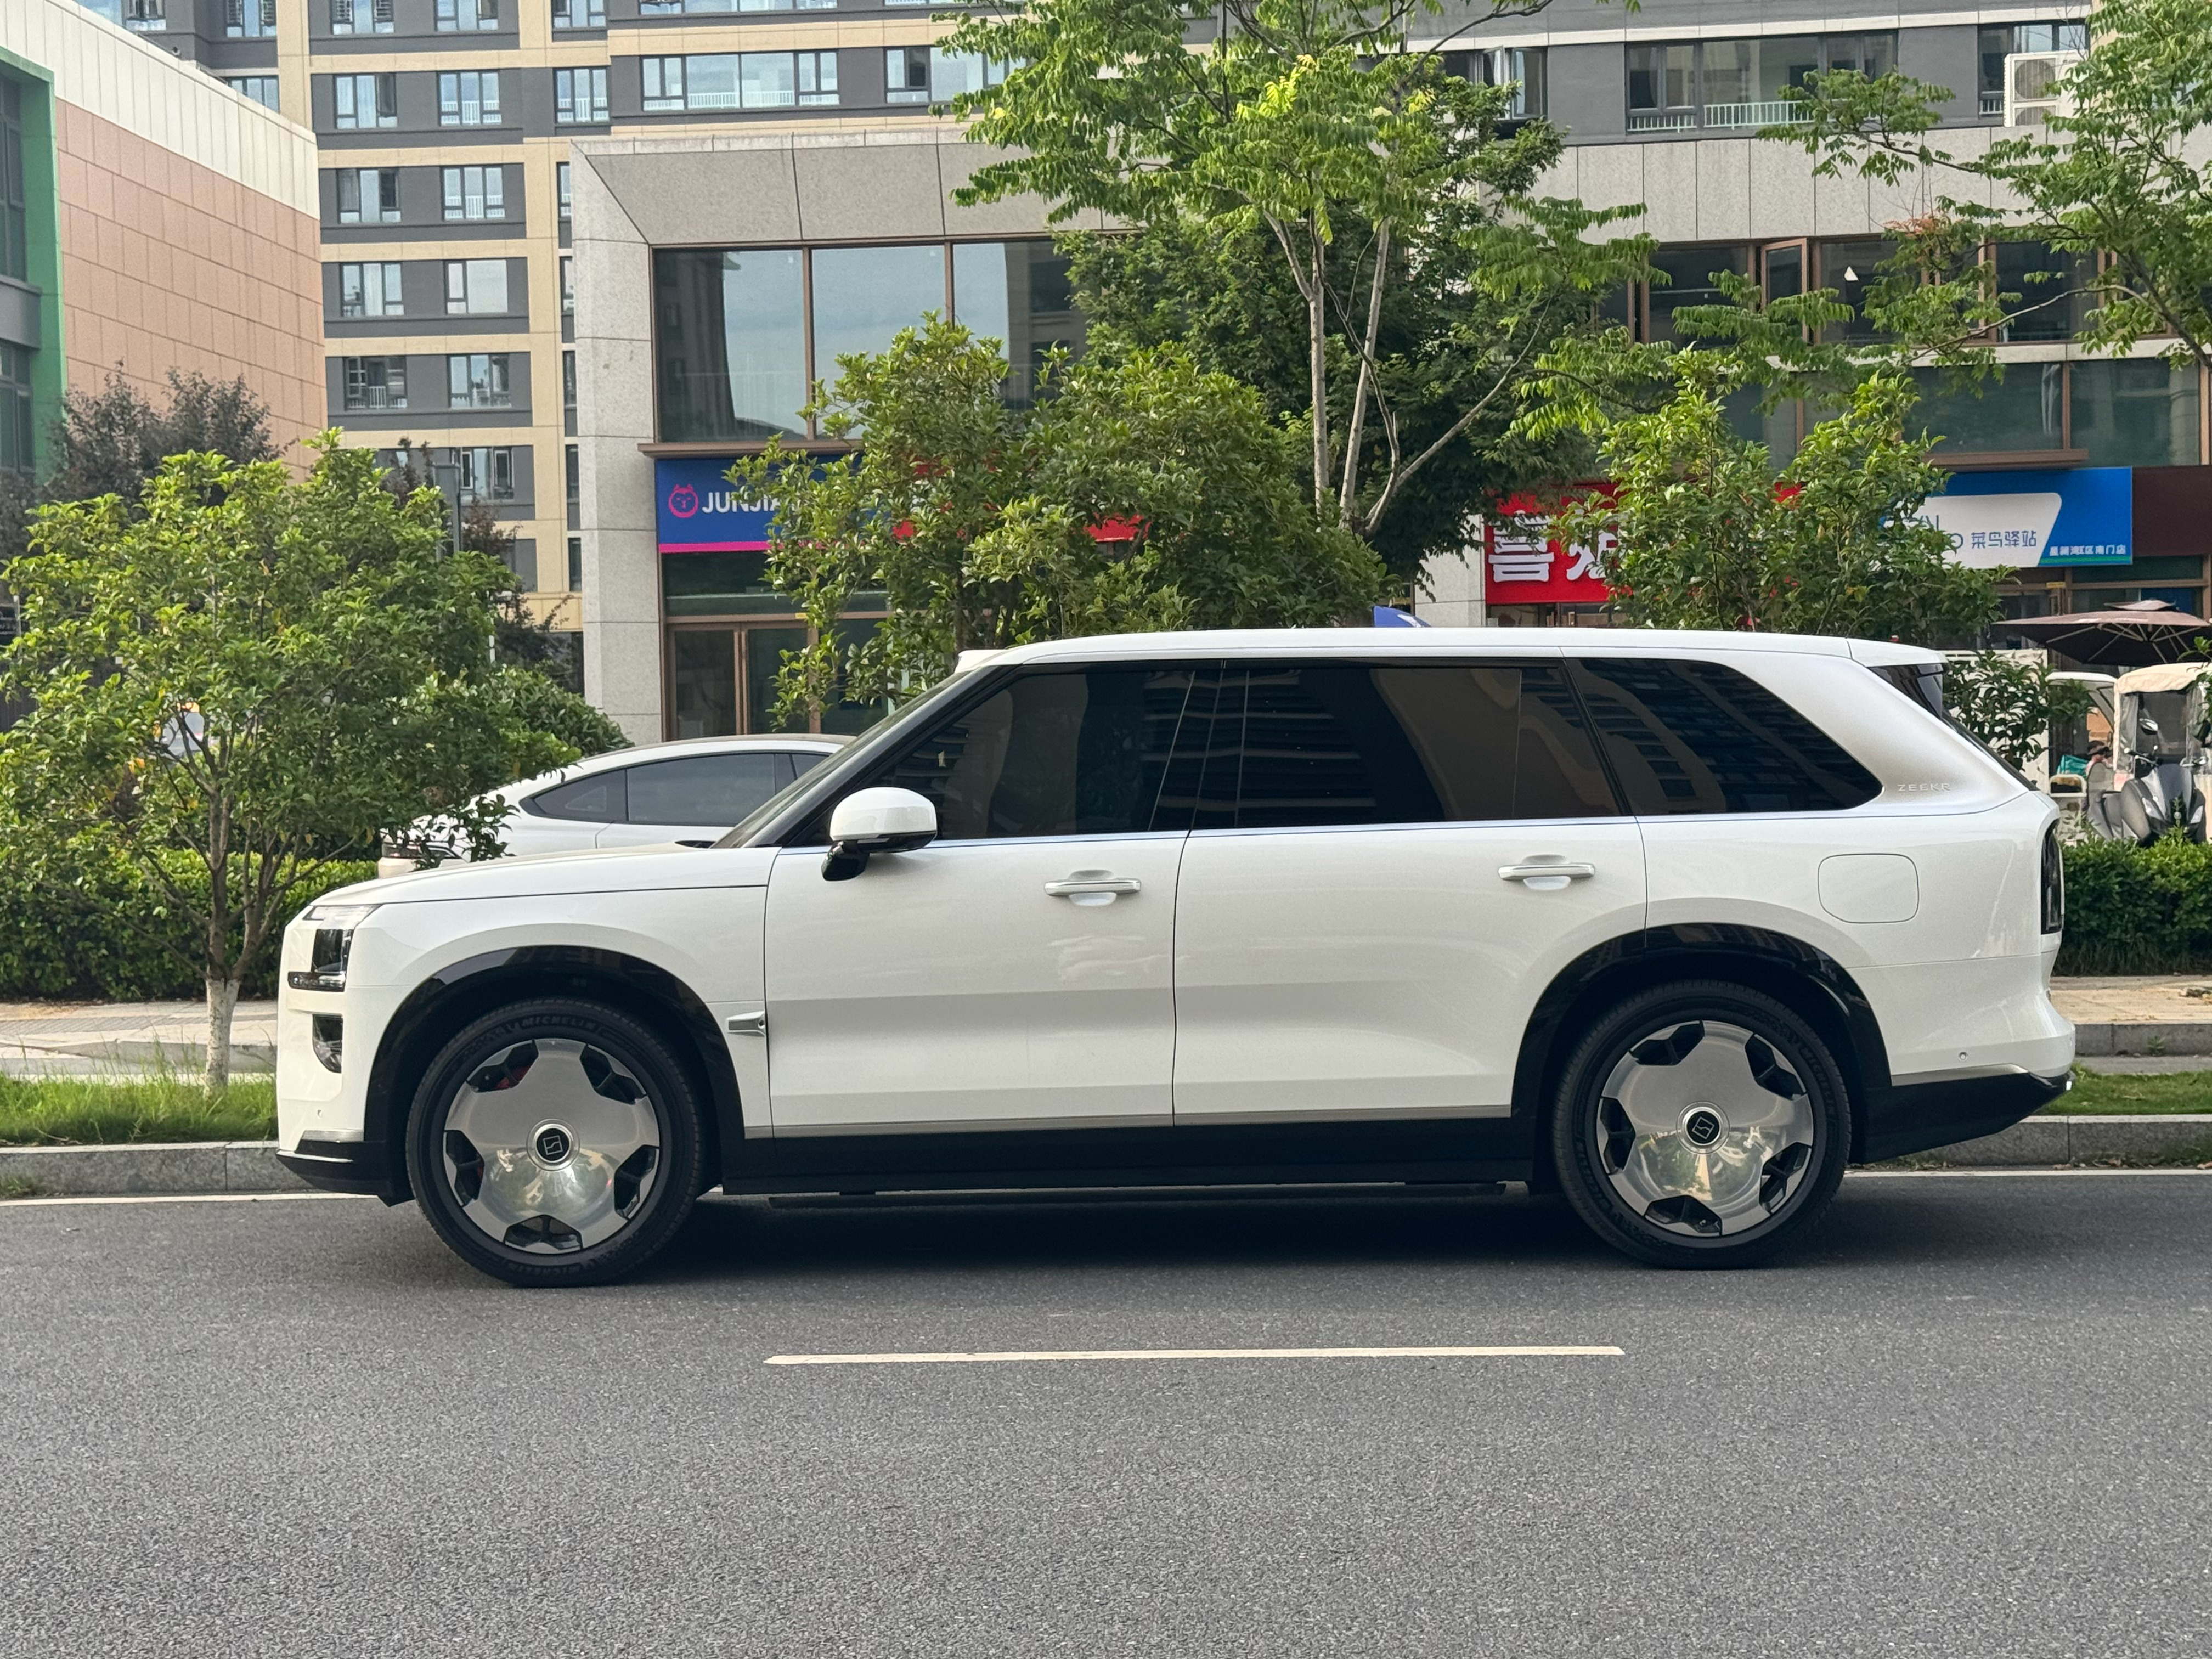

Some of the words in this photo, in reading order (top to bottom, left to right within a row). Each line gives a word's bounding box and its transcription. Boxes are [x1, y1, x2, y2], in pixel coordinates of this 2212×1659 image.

[1971, 530, 2037, 549] 菜鸟驿站
[1897, 783, 1951, 792] ZEEKR
[522, 1015, 596, 1031] MICHELIN
